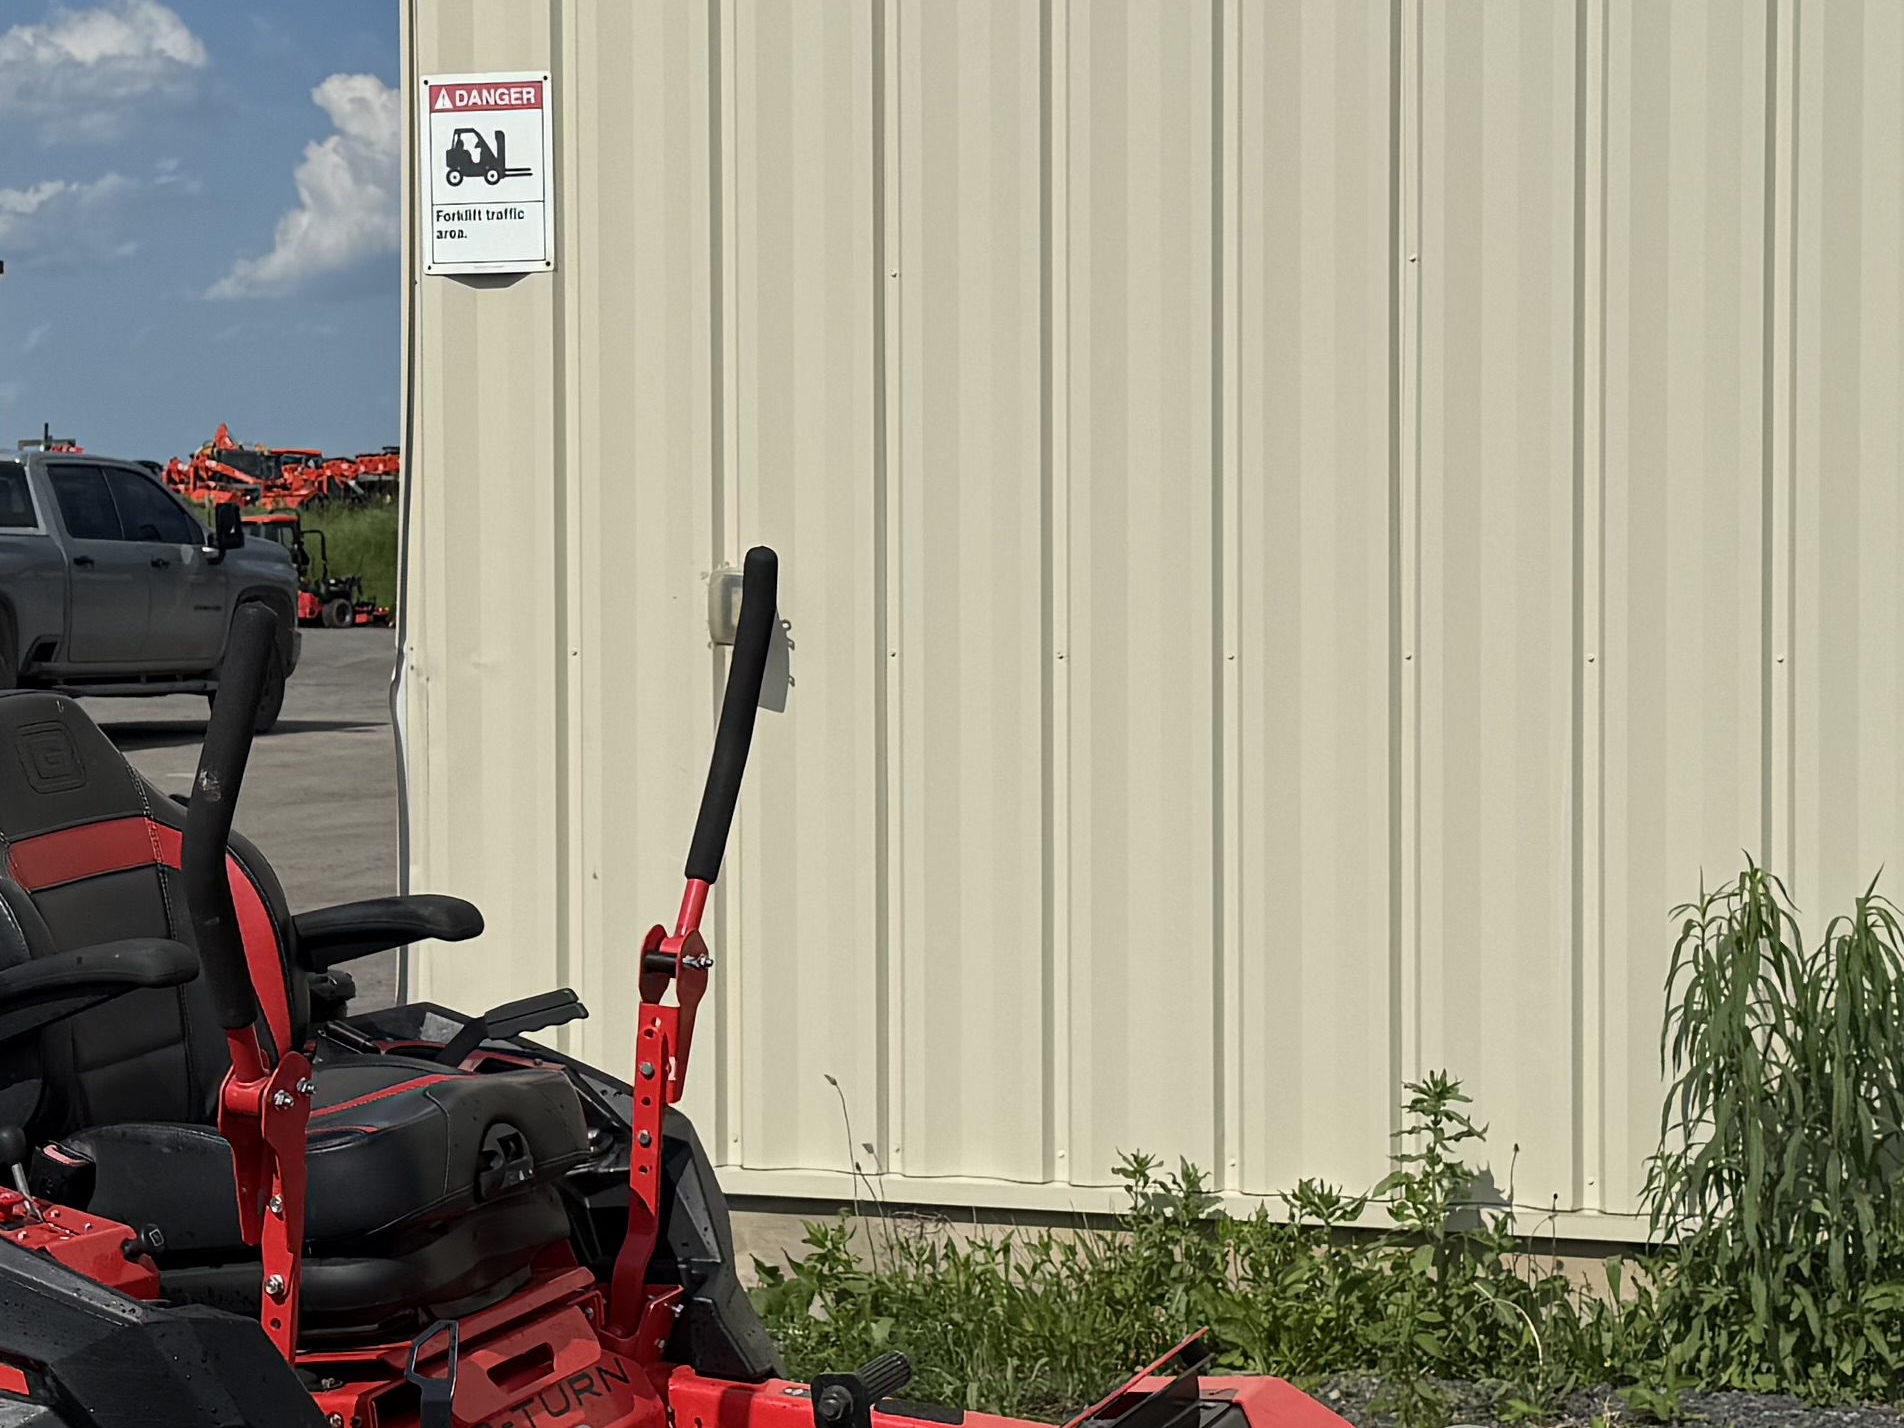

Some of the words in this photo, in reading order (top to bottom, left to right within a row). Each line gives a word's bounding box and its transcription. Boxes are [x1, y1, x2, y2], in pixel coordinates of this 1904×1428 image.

[455, 87, 535, 106] DANGER
[436, 208, 483, 222] Forklift
[485, 207, 525, 221] traffic
